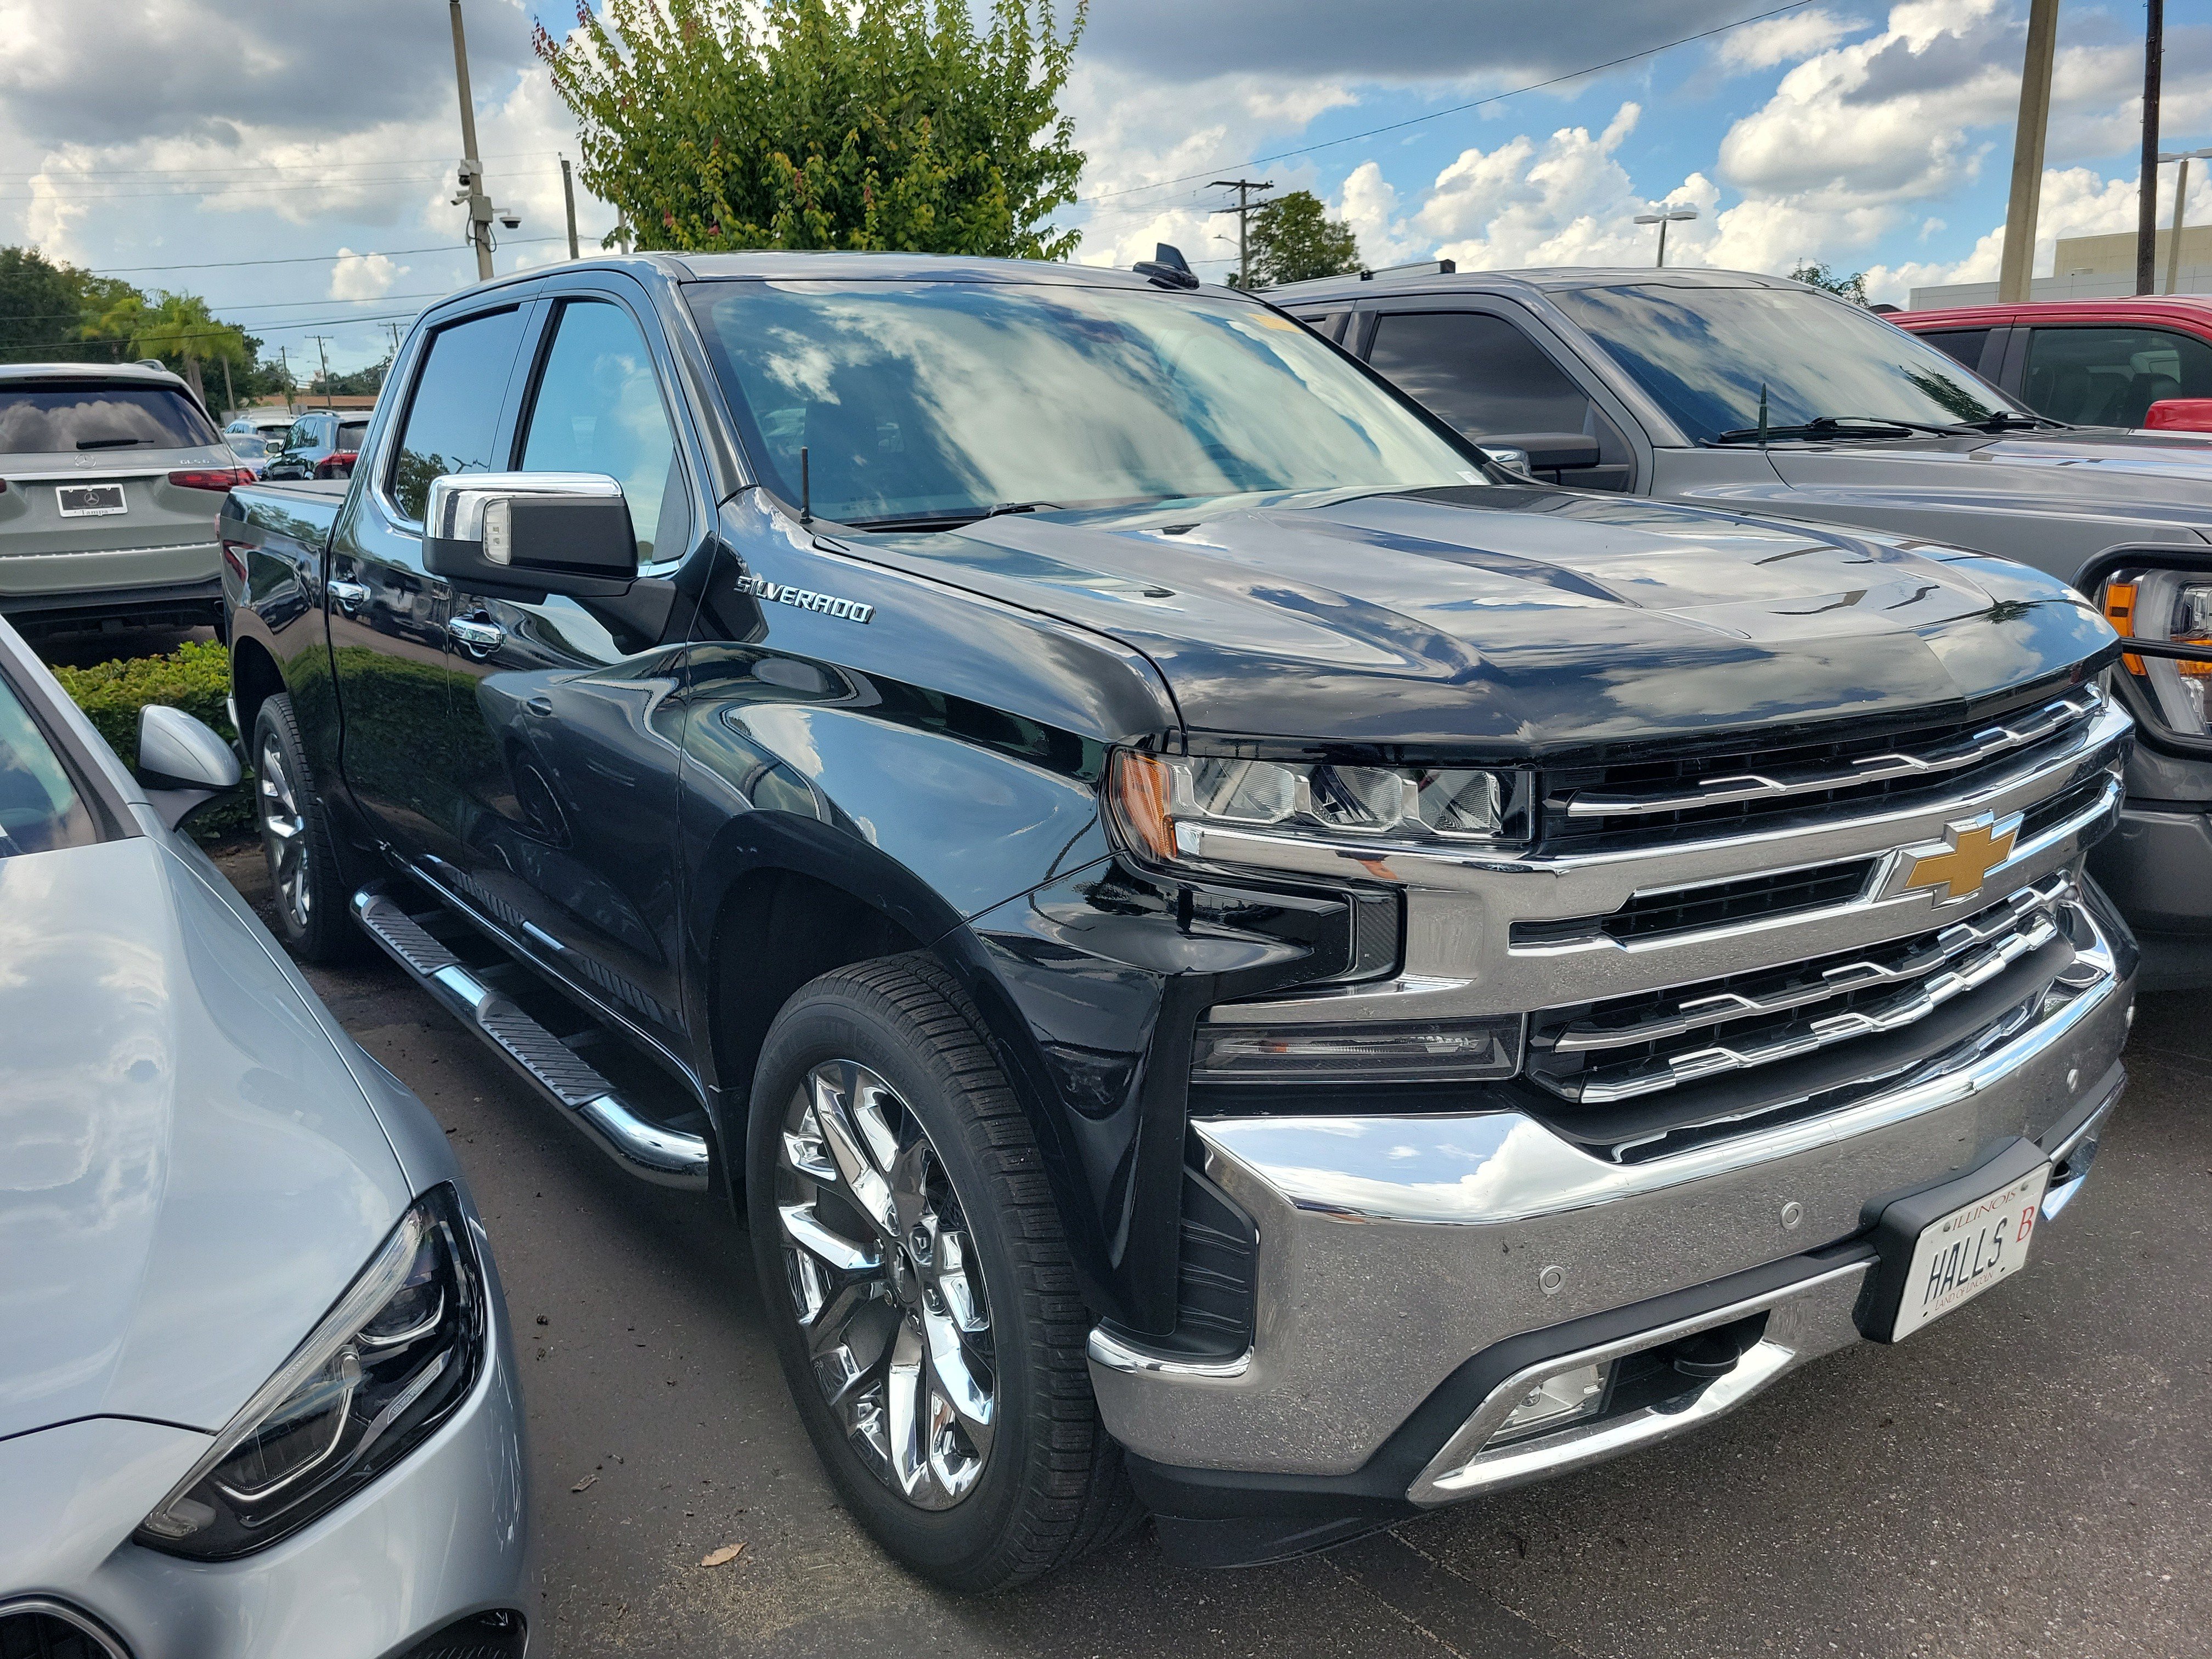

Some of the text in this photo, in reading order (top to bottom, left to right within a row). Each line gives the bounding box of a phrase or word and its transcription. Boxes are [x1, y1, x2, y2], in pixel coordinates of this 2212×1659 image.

[733, 575, 876, 624] SILVERADO
[1952, 1187, 2018, 1231] ILLINOIS
[1923, 1206, 2035, 1306] HALLS B
[1934, 1271, 1994, 1311] LAND OF LINCOLN
[391, 1368, 439, 1414] LED HIGH PERFORMANCE
